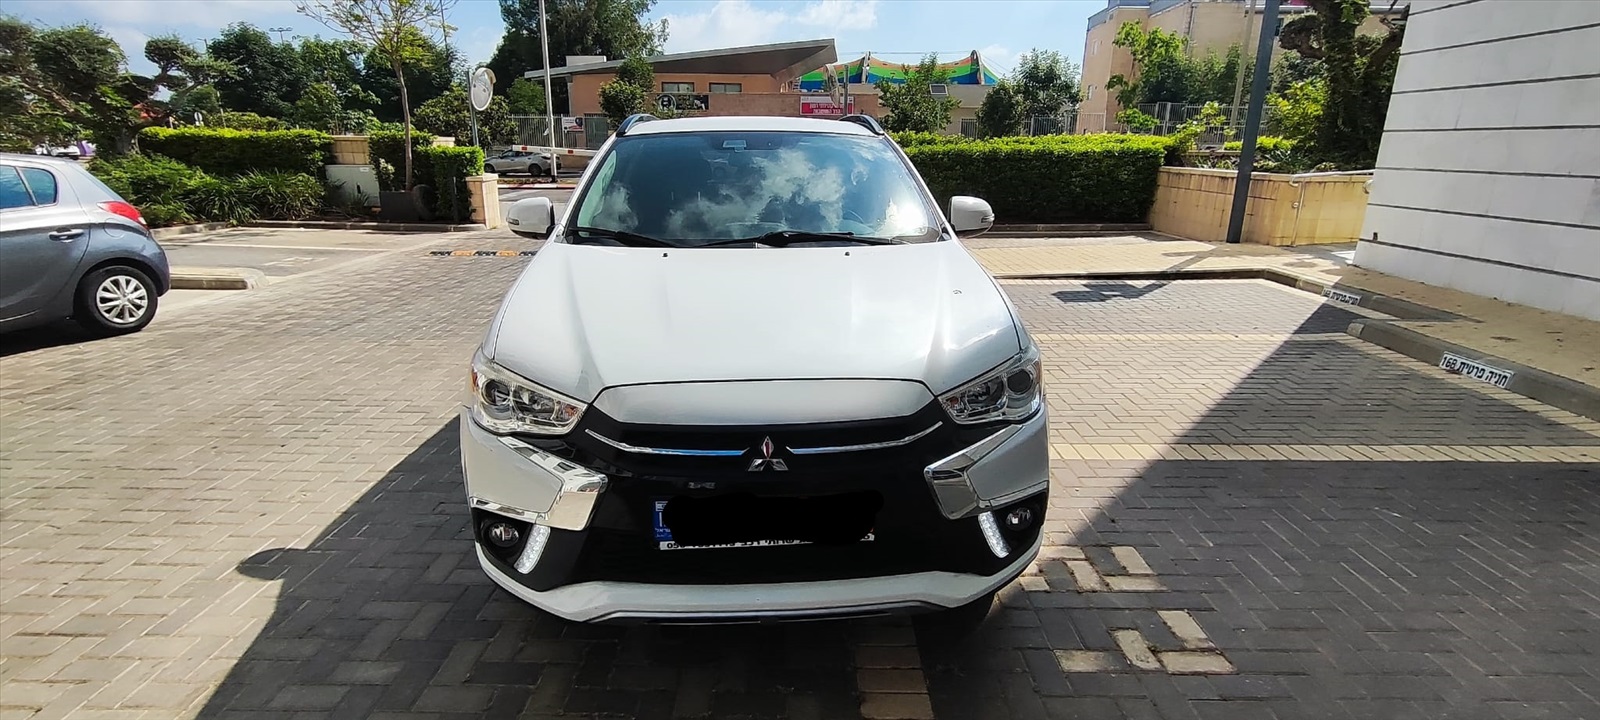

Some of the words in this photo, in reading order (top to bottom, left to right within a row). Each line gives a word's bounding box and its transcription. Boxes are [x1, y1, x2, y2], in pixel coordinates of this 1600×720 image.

[1441, 356, 1458, 369] 168
[1456, 361, 1486, 379] פרטית
[1485, 370, 1509, 387] חניה
